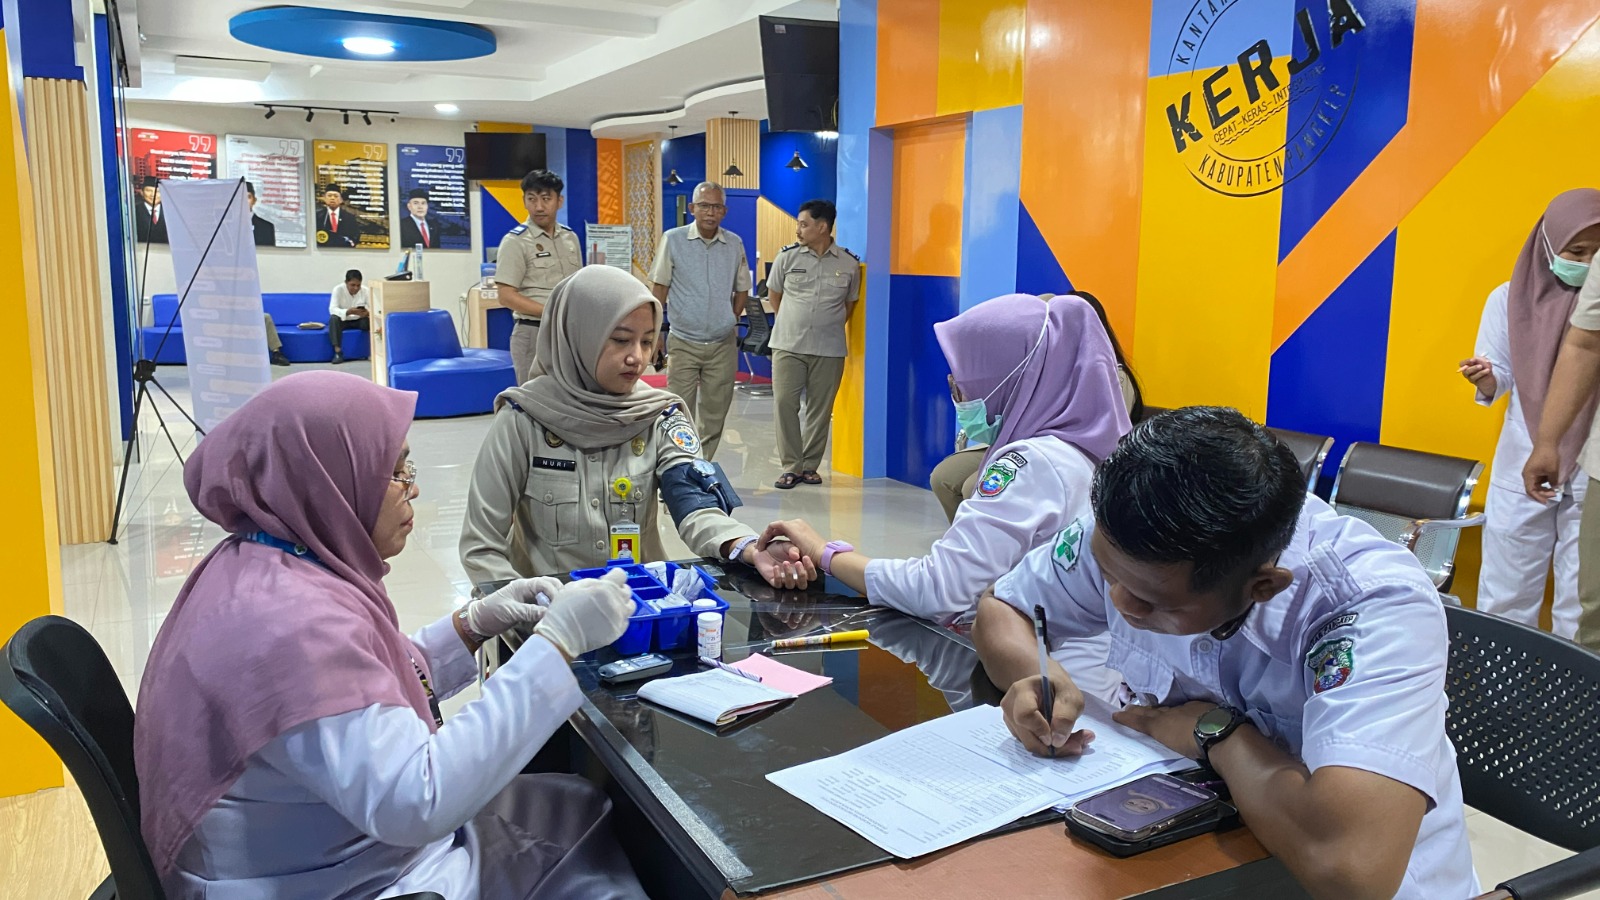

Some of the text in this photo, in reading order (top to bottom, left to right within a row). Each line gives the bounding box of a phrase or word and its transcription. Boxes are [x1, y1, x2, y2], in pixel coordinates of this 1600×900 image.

[1166, 0, 1366, 153] KERJA
[1198, 153, 1284, 187] KABUPATEN
[542, 459, 566, 468] NURI
